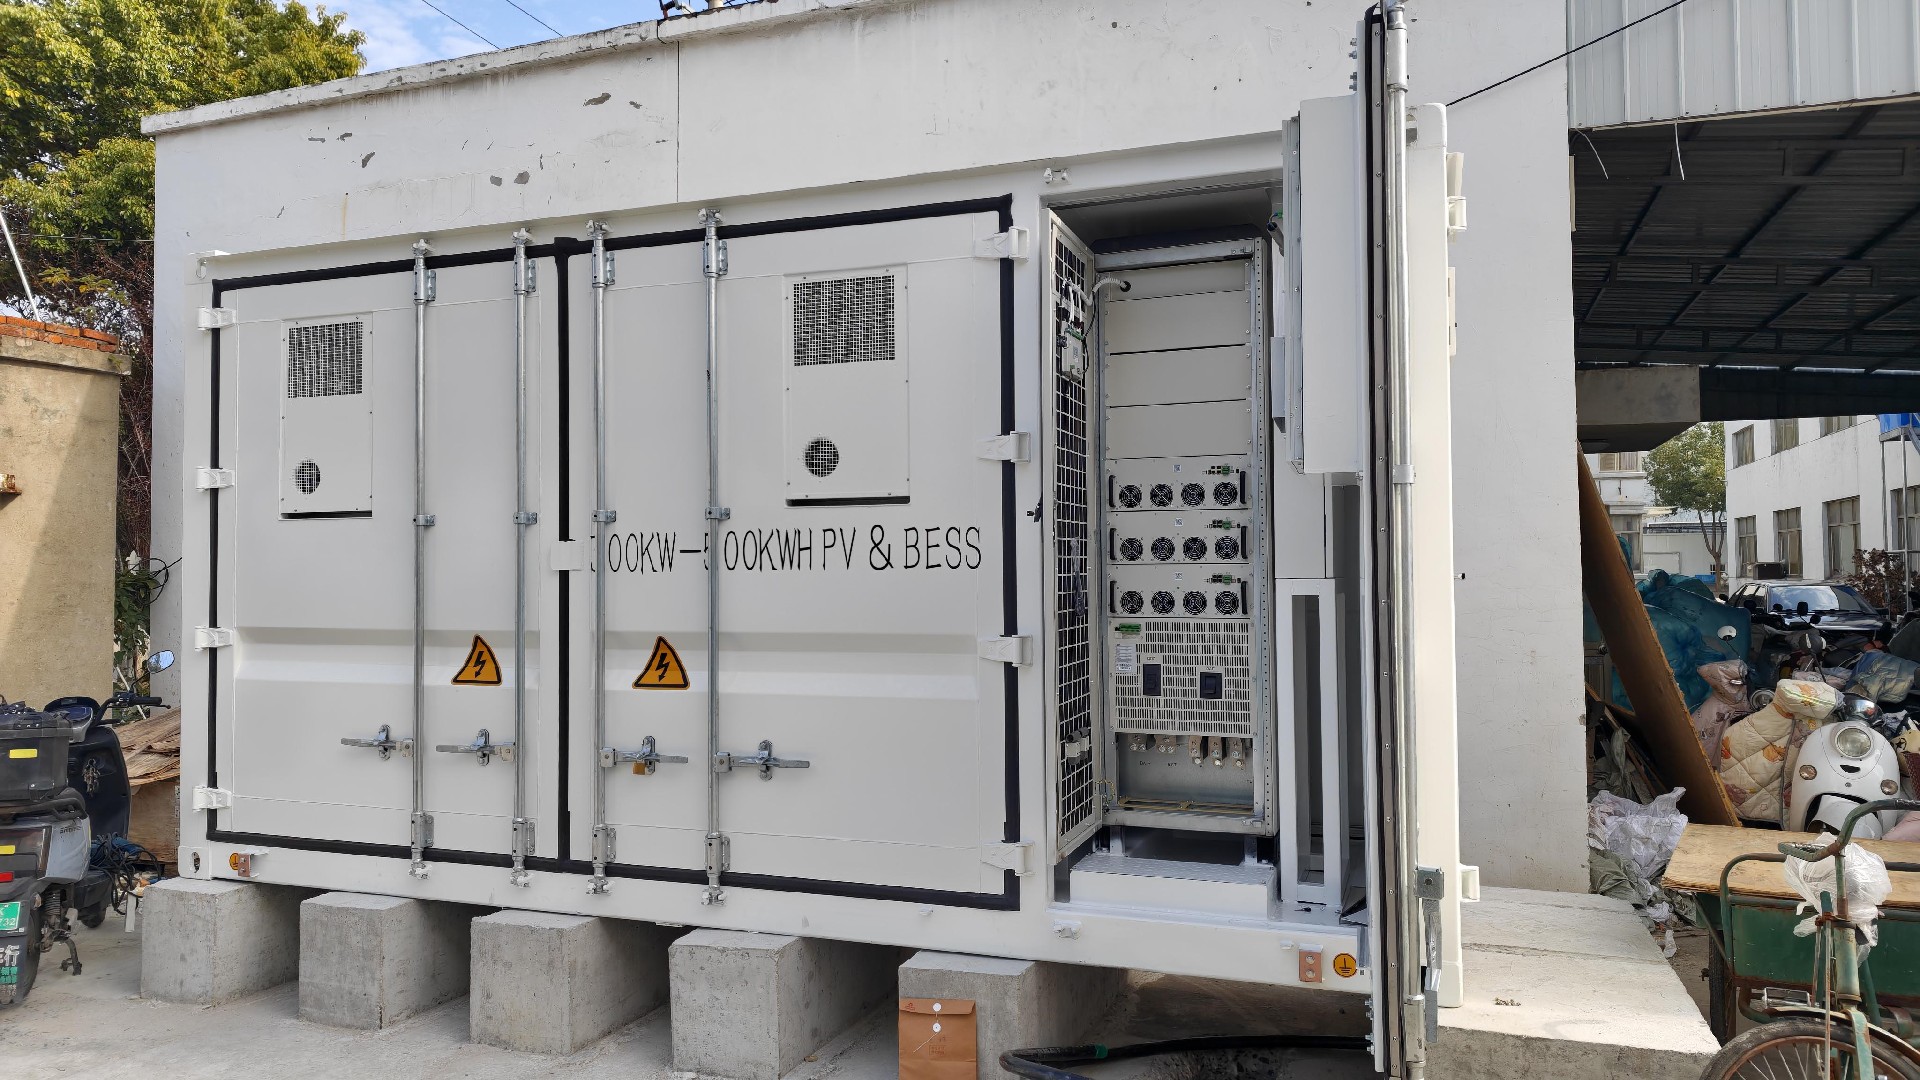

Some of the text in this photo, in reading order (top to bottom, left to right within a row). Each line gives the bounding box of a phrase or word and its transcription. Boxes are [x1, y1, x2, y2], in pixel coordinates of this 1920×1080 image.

[822, 527, 856, 571] PV
[869, 524, 894, 571] &
[903, 526, 982, 570] BESS
